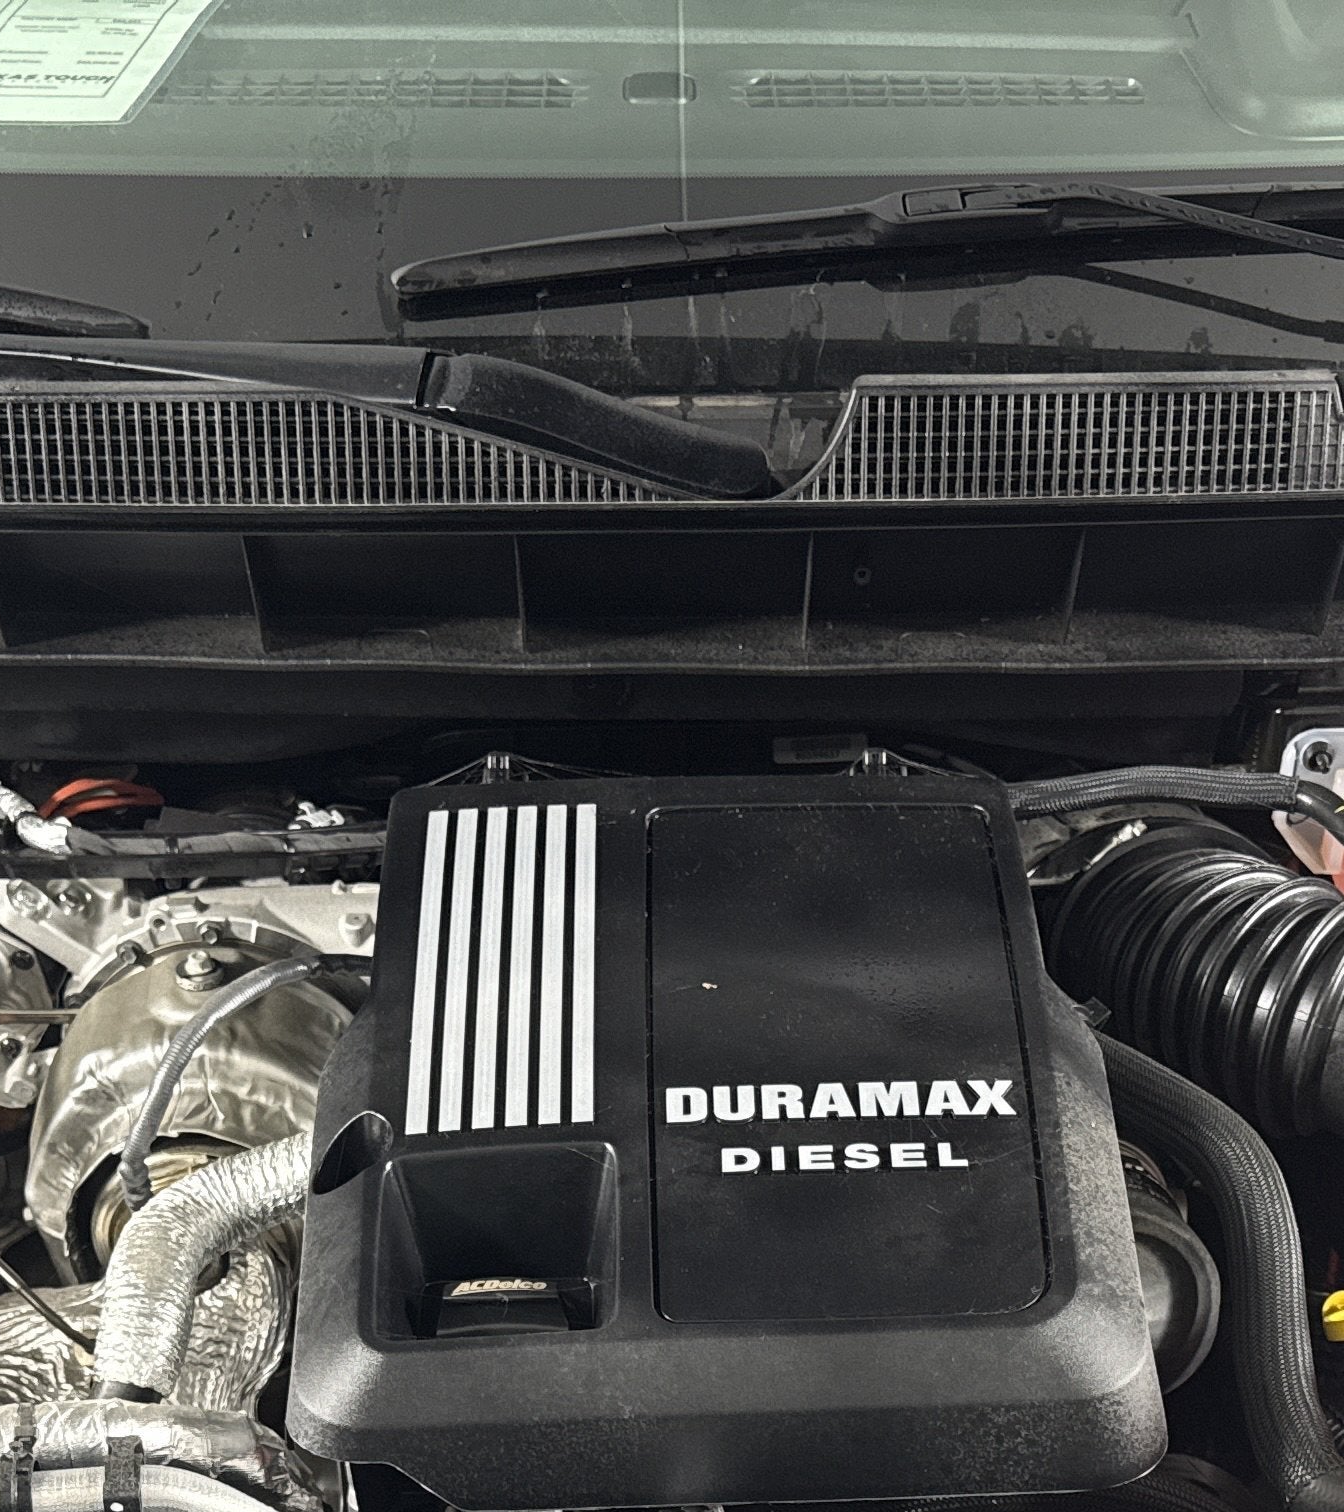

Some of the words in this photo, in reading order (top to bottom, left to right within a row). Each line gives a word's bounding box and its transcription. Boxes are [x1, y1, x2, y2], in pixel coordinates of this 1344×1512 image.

[44, 73, 116, 84] TOUCH
[665, 1079, 1018, 1124] DURAMAX
[721, 1142, 970, 1174] DIESEL
[451, 1278, 548, 1295] ACDelco
